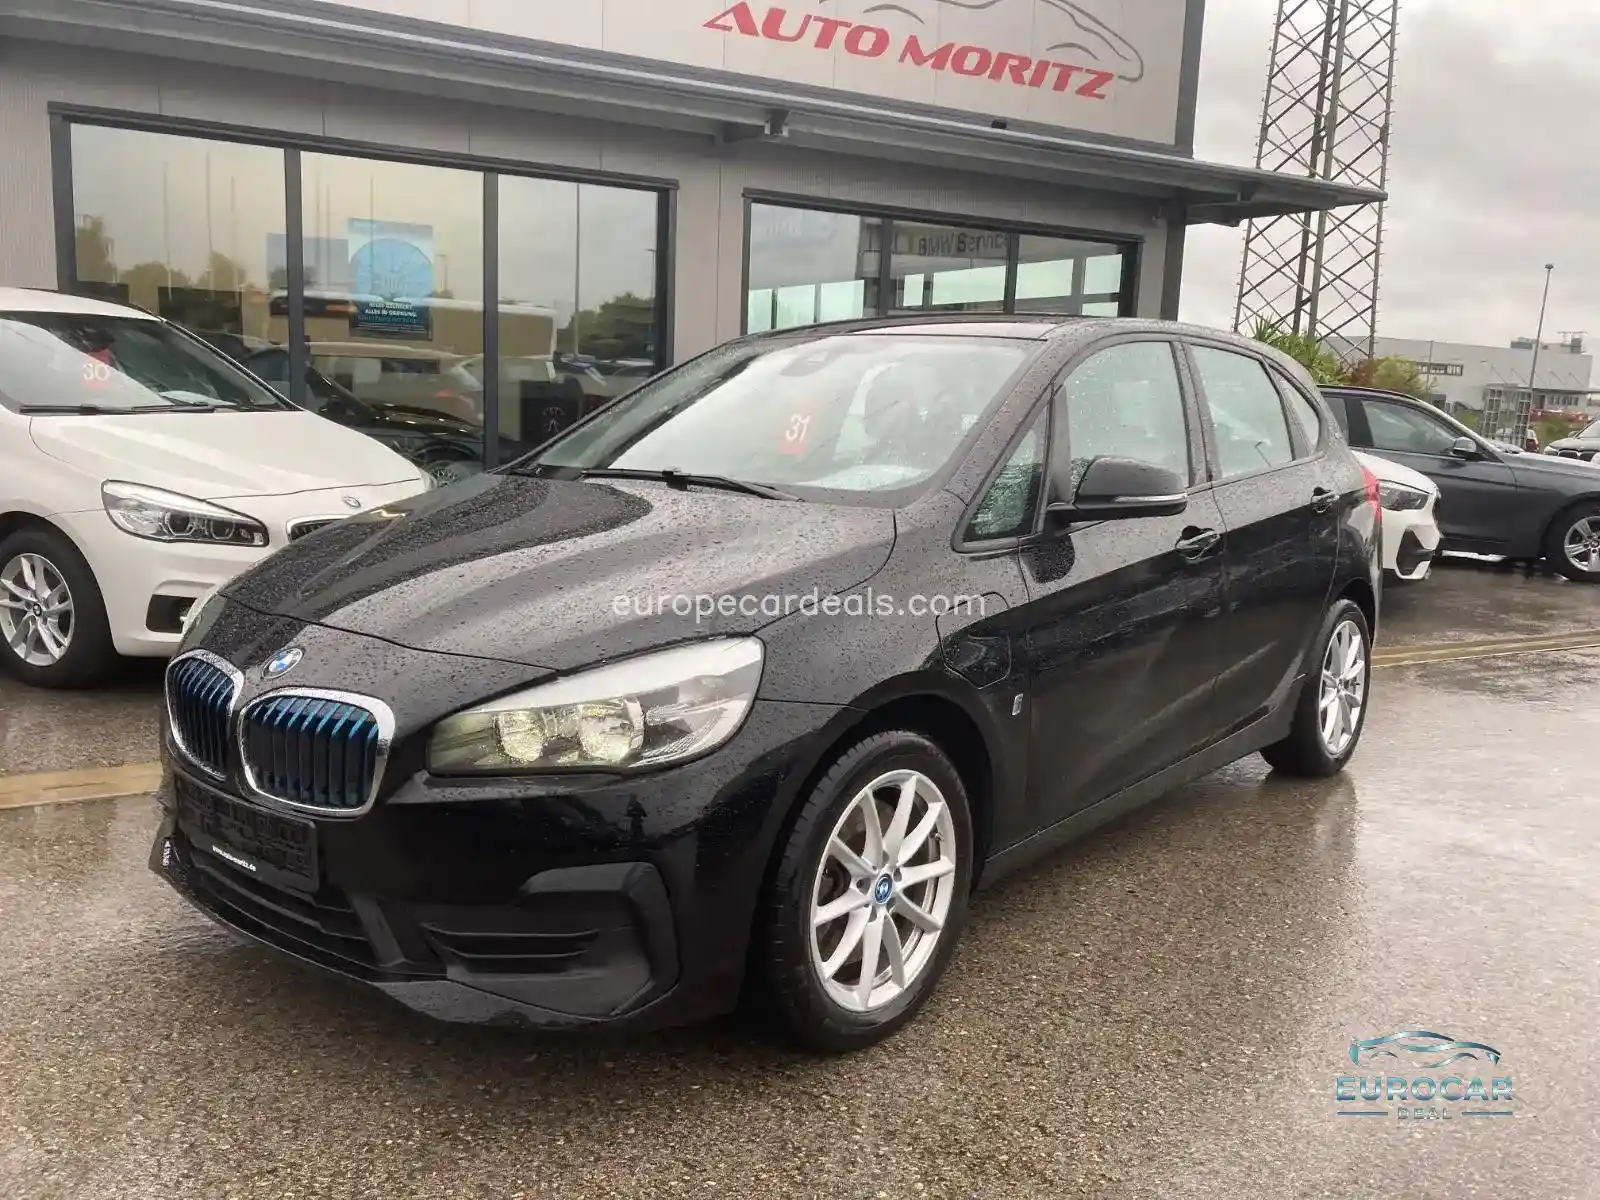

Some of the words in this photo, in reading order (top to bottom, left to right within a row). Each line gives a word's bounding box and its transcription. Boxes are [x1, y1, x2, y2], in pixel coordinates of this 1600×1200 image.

[702, 0, 890, 58] AUTO
[898, 34, 1115, 99] MORITZ
[83, 363, 110, 381] 30
[785, 413, 812, 444] 31
